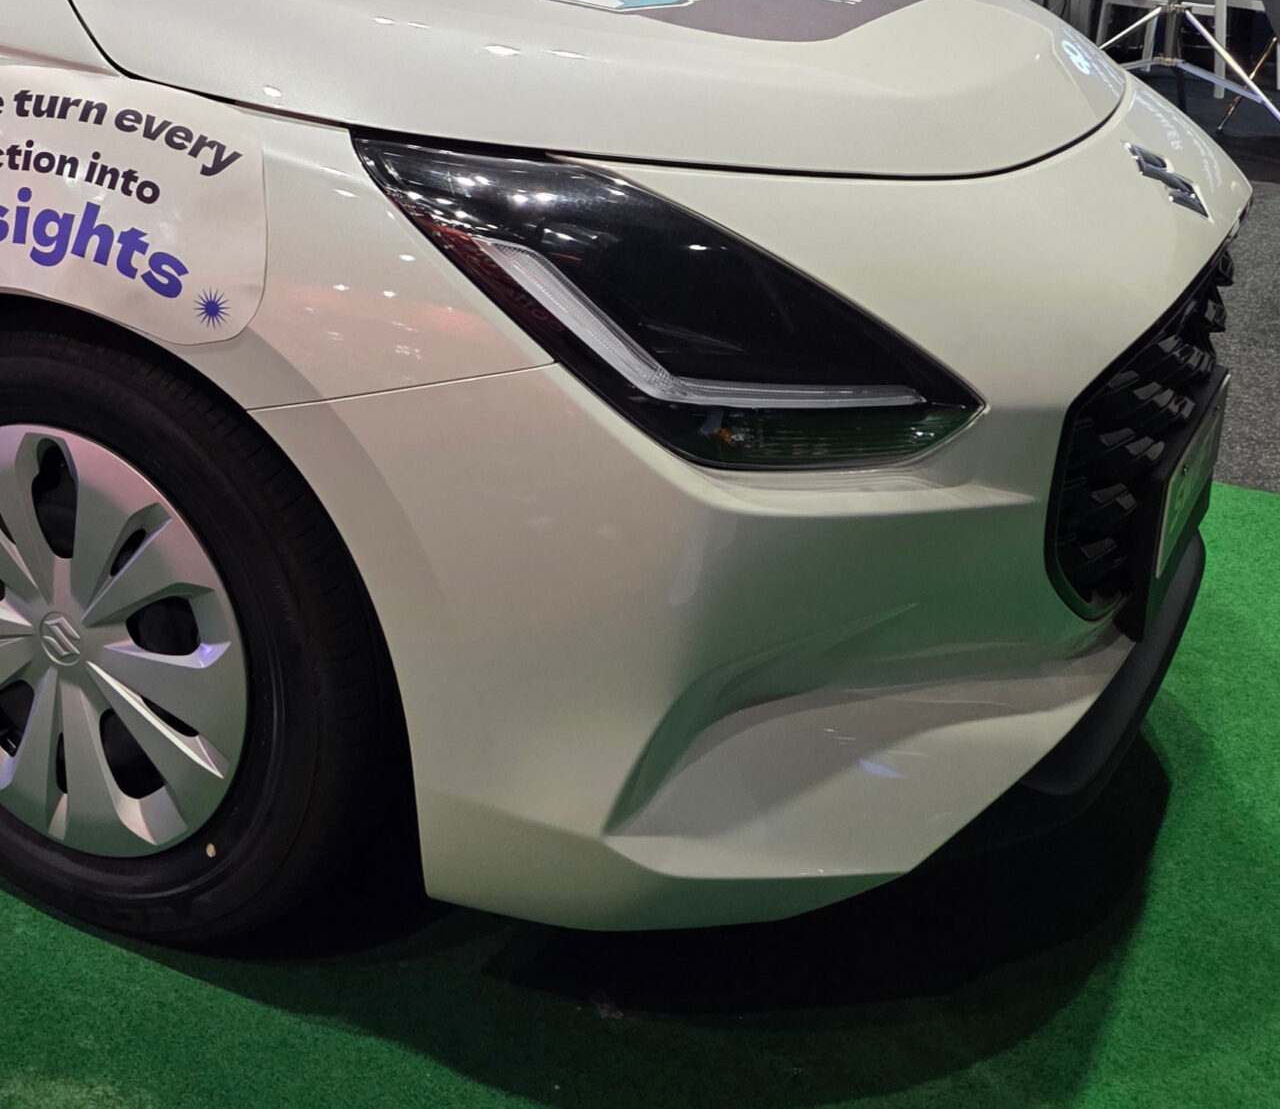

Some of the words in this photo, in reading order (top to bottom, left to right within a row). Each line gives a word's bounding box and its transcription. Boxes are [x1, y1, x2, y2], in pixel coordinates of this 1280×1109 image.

[14, 89, 108, 125] turn
[114, 108, 242, 177] every
[84, 152, 160, 204] into
